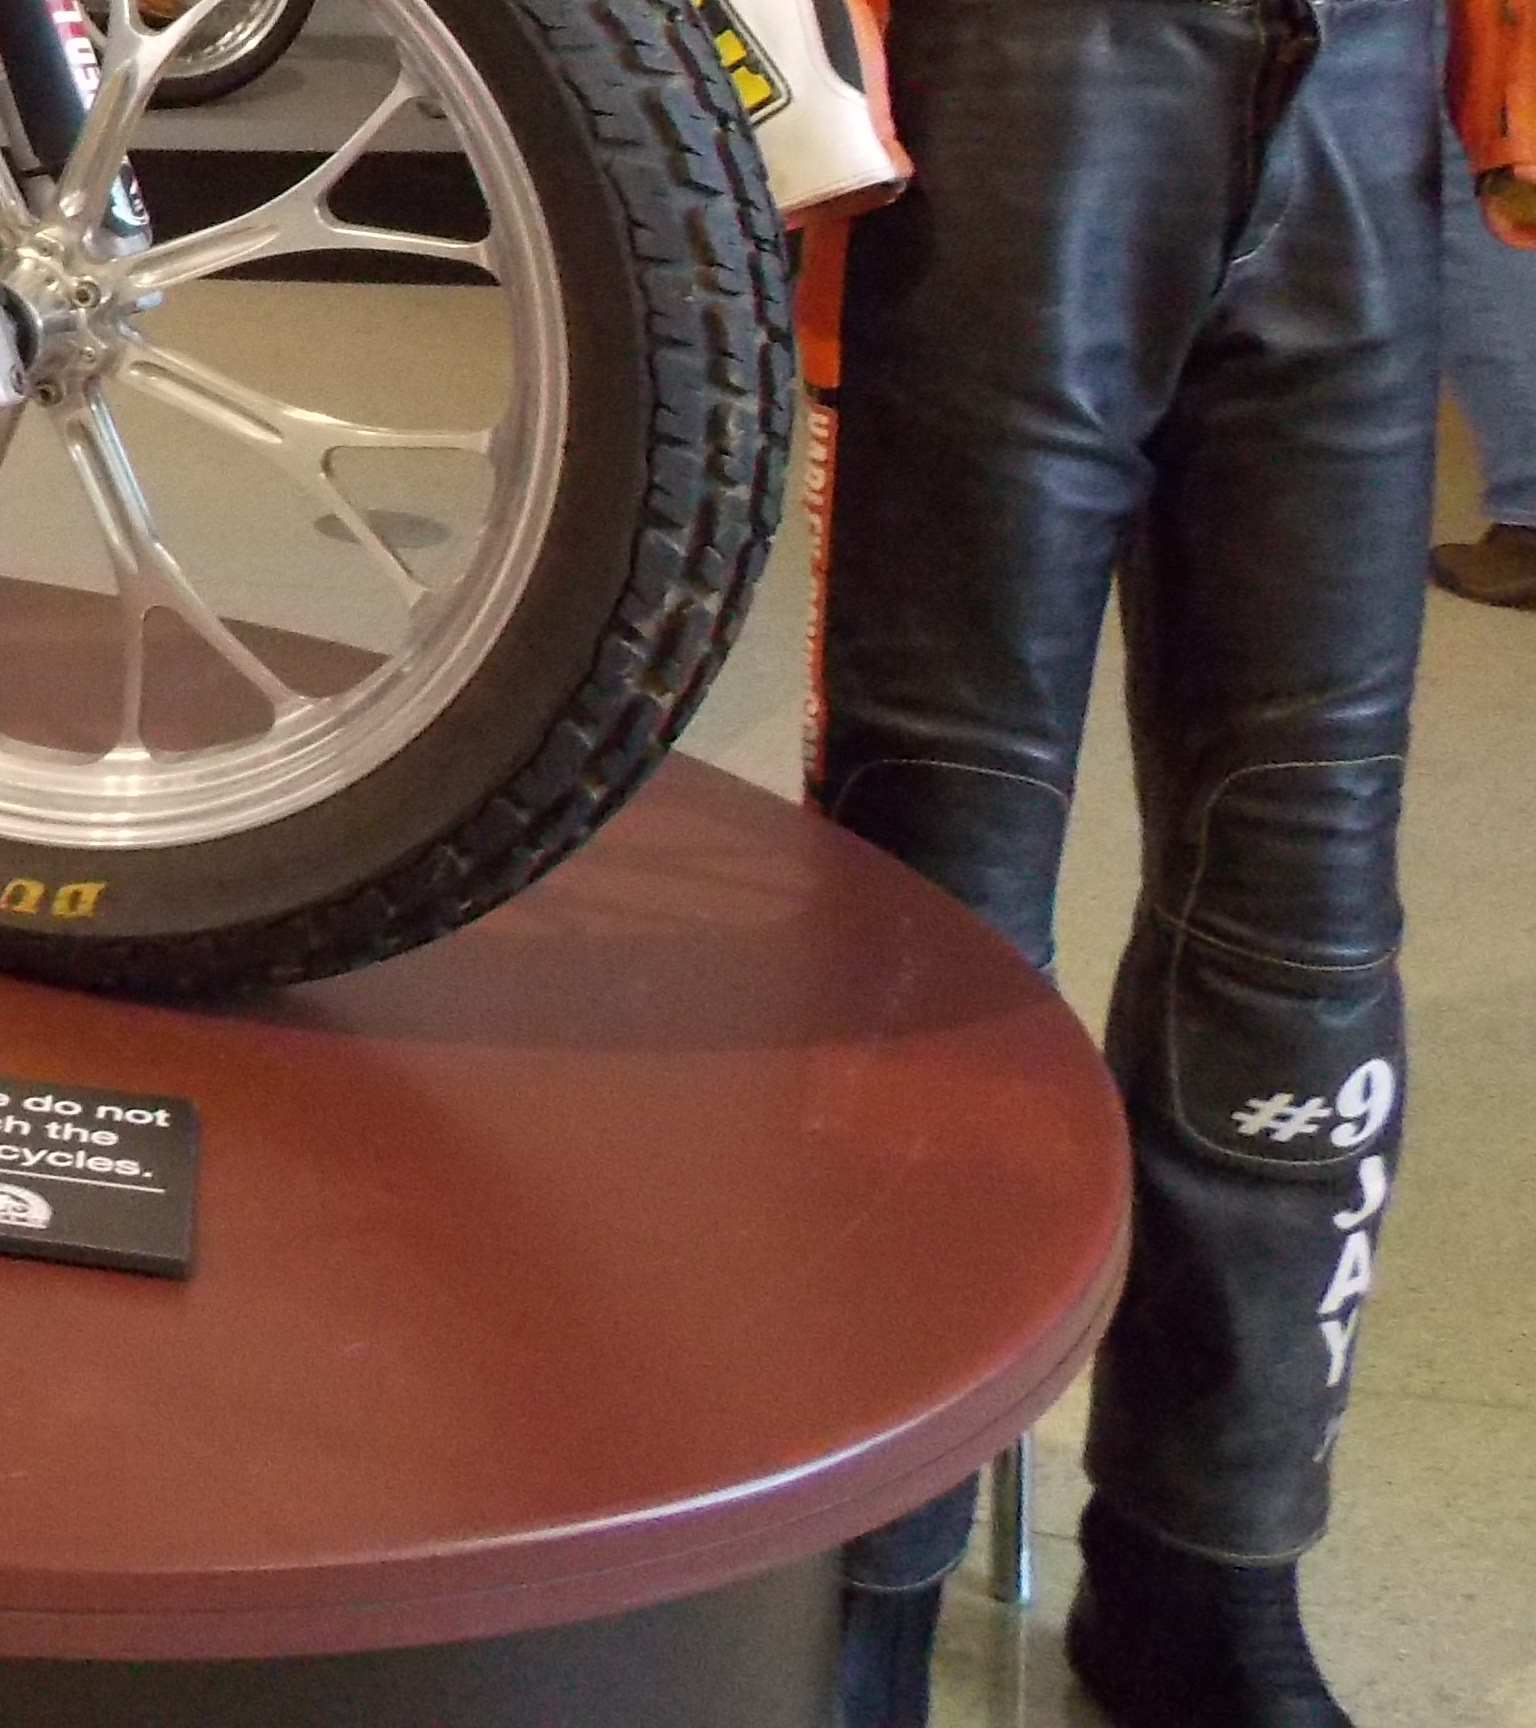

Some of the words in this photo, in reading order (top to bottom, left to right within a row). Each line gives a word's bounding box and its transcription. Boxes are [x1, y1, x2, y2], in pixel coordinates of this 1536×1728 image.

[23, 1080, 83, 1117] do
[95, 1091, 172, 1129] not
[44, 1119, 120, 1148] the
[1231, 1058, 1396, 1149] #9
[1316, 1153, 1388, 1388] JAY
